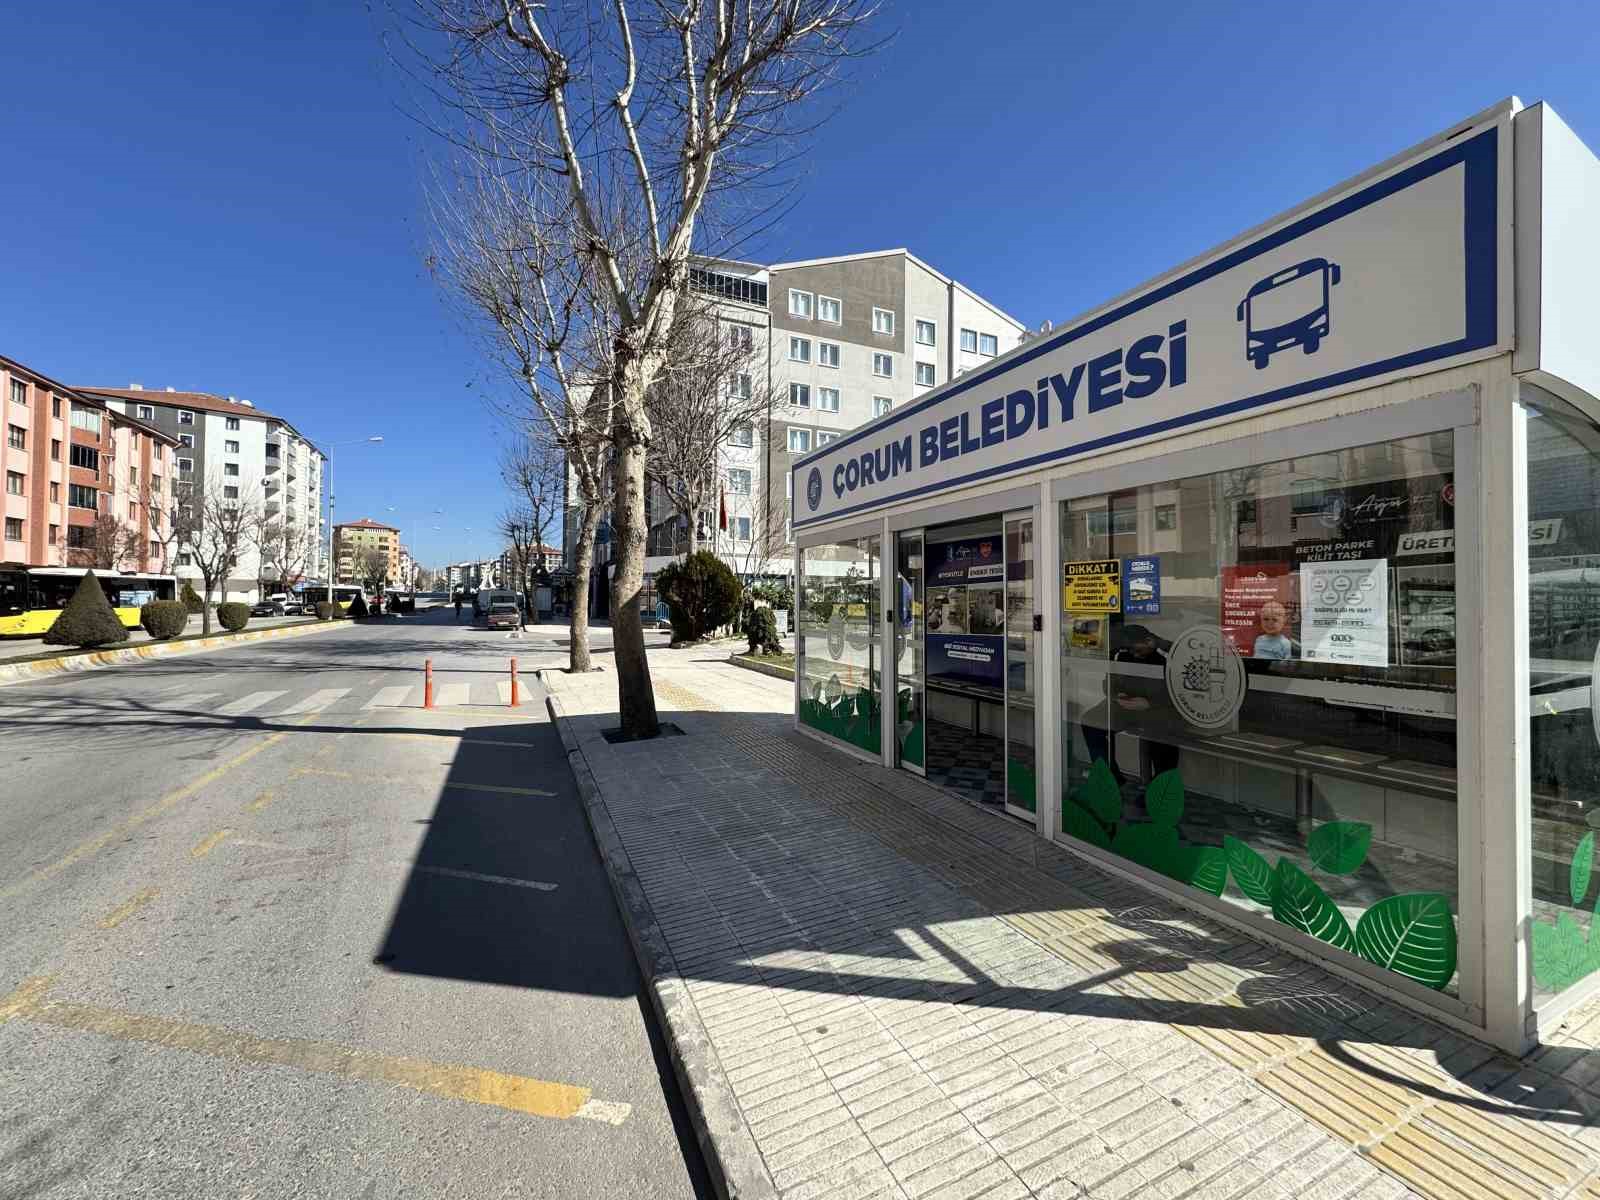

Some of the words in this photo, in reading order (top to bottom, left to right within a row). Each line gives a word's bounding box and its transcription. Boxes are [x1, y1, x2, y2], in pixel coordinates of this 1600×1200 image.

[832, 434, 912, 499] ÇORUM
[919, 318, 1187, 469] BELEDİYESİ
[1296, 543, 1332, 555] BETON
[1335, 540, 1375, 552] PARKE
[1403, 536, 1454, 551] ÜRET
[1306, 551, 1335, 562] KİLİT
[1069, 563, 1107, 575] DİKKAT
